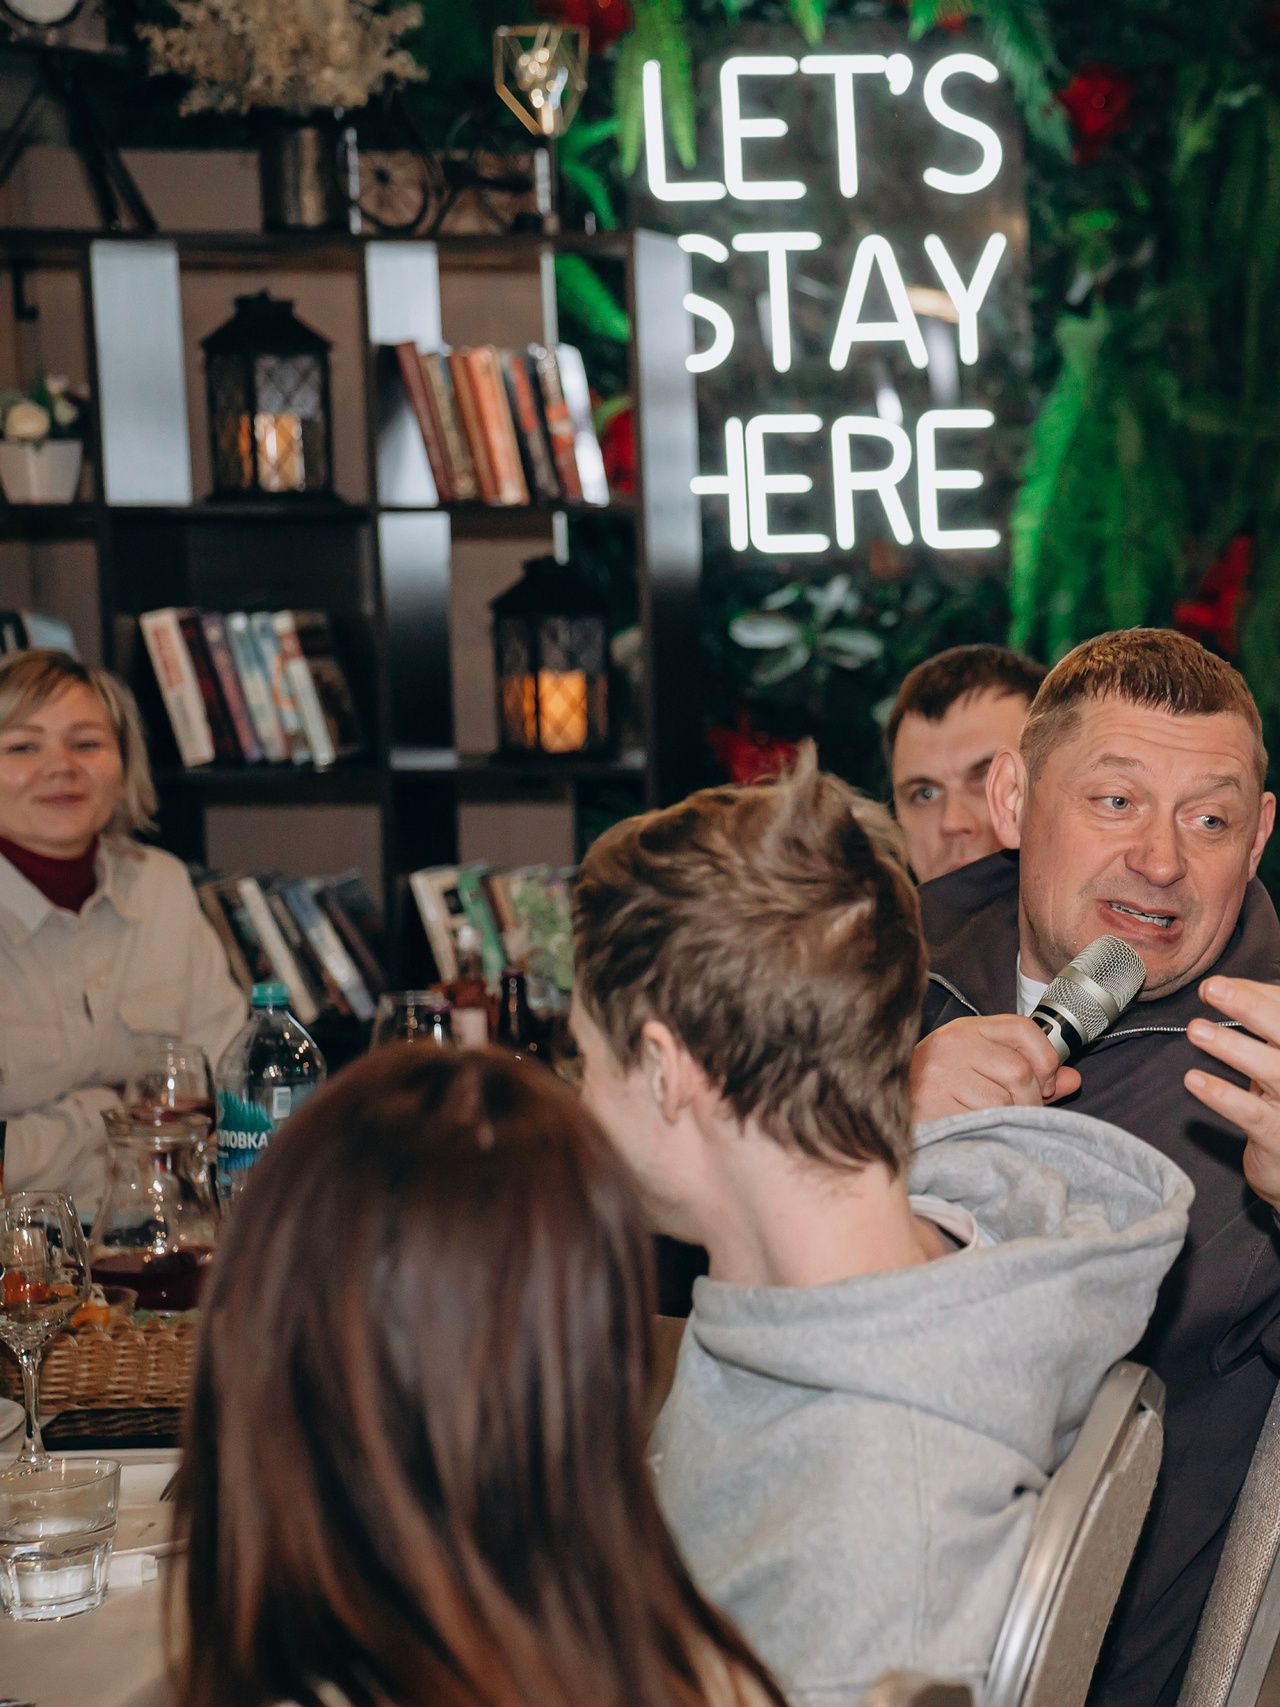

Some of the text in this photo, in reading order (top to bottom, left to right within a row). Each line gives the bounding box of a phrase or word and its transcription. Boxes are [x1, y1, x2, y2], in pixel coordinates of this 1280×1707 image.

[642, 53, 1003, 201] LET'S
[678, 232, 1007, 373] STAY
[689, 408, 1001, 553] HERE
